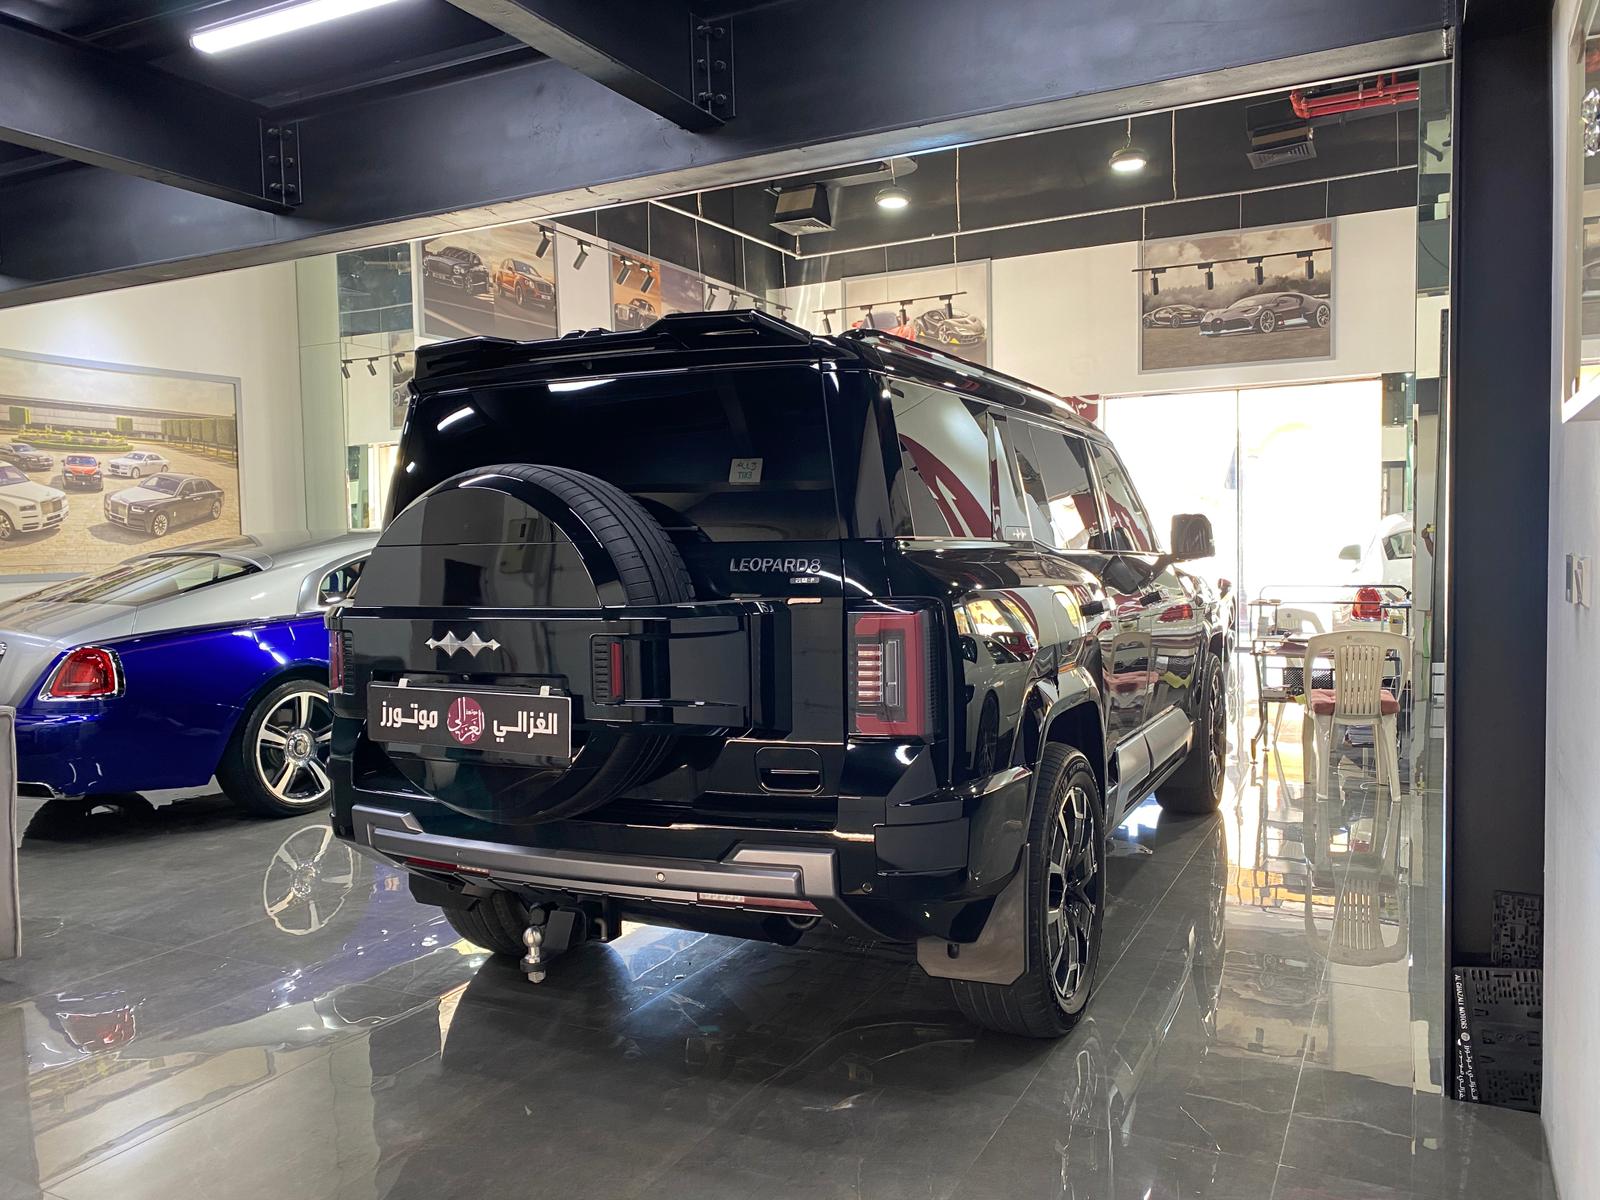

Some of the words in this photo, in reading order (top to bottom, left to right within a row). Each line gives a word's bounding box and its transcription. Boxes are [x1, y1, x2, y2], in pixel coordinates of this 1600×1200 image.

[379, 701, 439, 731] موتورز
[492, 710, 558, 743] الغزالي
[1454, 974, 1462, 982] AL
[1455, 982, 1465, 1006] GHAZALI
[1458, 1006, 1468, 1030] MOTORS
